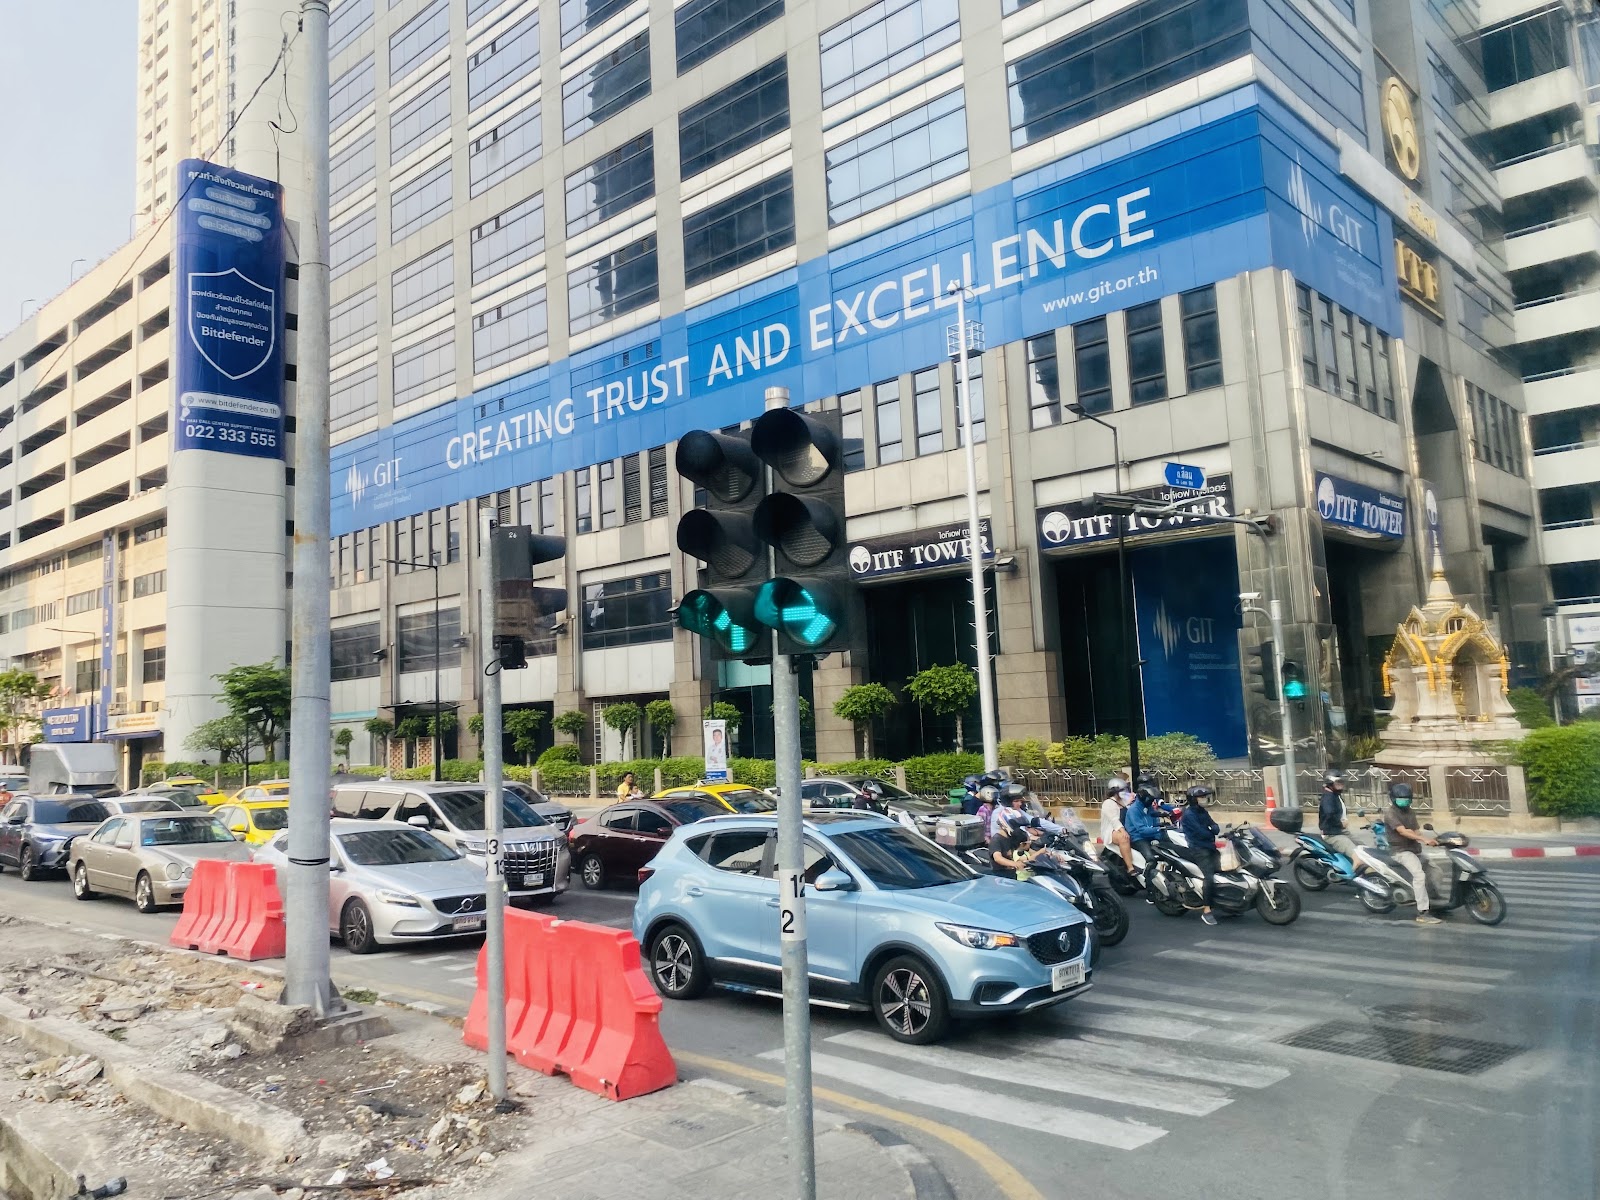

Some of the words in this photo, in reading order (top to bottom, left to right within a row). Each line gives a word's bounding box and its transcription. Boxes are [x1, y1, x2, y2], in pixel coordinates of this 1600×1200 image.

[1329, 205, 1363, 257] GIT
[1042, 267, 1157, 314] www.git.or.th
[201, 326, 265, 347] Bitdefender
[446, 398, 575, 470] CREATING
[587, 355, 689, 425] TRUST
[707, 322, 791, 387] AND
[809, 187, 1155, 351] EXCELLENCE
[198, 397, 277, 414] www.bitdefender.co.th
[186, 425, 215, 440] 022
[219, 427, 246, 443] 333
[250, 431, 276, 447] 555
[374, 457, 402, 487] GIT
[1072, 514, 1112, 540] ITF
[1335, 494, 1358, 523] ITF
[1362, 501, 1403, 535] TOWER
[872, 549, 903, 571] ITF
[1186, 616, 1216, 644] GIT
